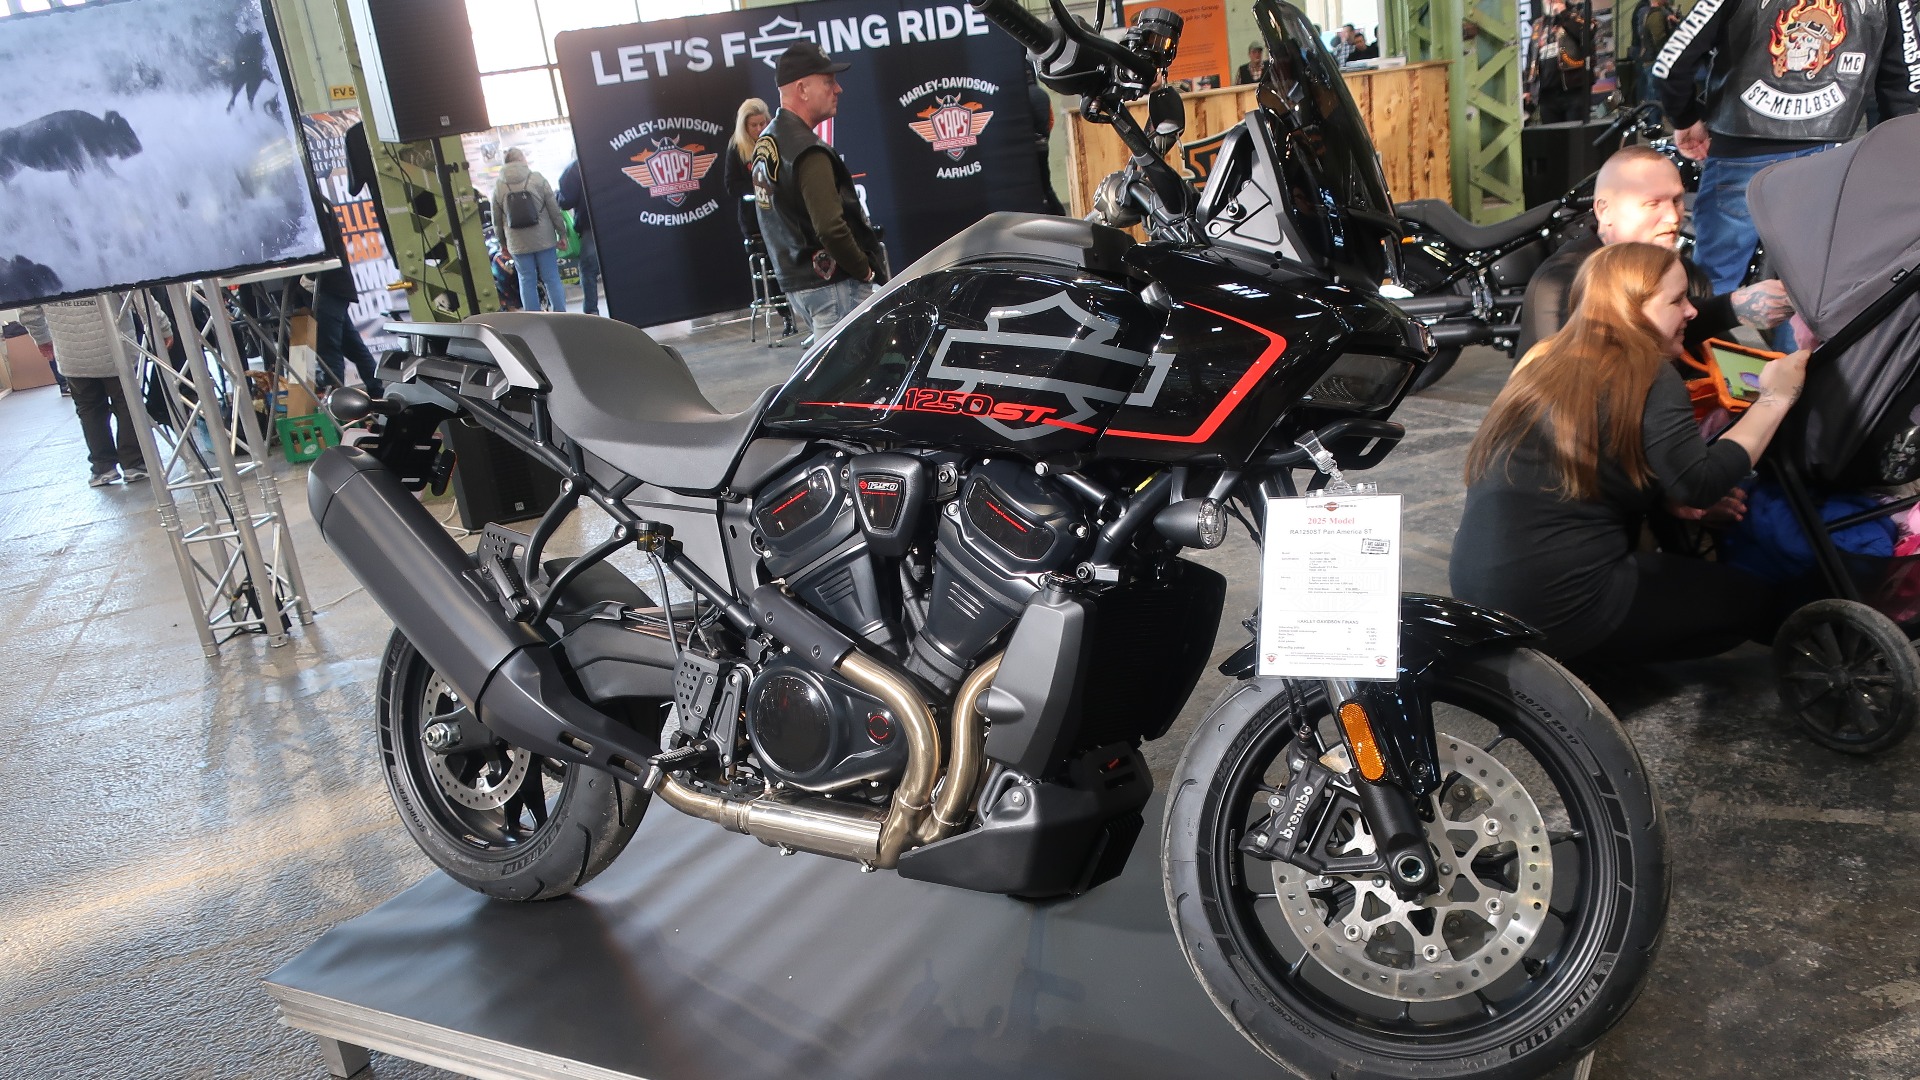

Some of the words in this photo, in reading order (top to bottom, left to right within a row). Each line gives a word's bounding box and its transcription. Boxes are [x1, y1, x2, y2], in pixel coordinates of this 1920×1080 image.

[591, 37, 713, 85] LET'S
[898, 3, 990, 44] RIDE
[1652, 0, 1724, 79] DANMAR
[1841, 56, 1862, 72] MC
[333, 88, 346, 97] FV
[935, 109, 968, 139] CAPS
[652, 151, 689, 184] CAPS
[937, 161, 981, 178] AARHUS
[640, 199, 719, 226] COPENHAGEN
[867, 481, 898, 491] 1250
[1329, 517, 1355, 525] Model
[1515, 690, 1552, 718] 120/70
[1279, 786, 1313, 839] brembo
[1268, 1001, 1317, 1039] SCORCHER
[1515, 978, 1600, 1055] MICHELIN
